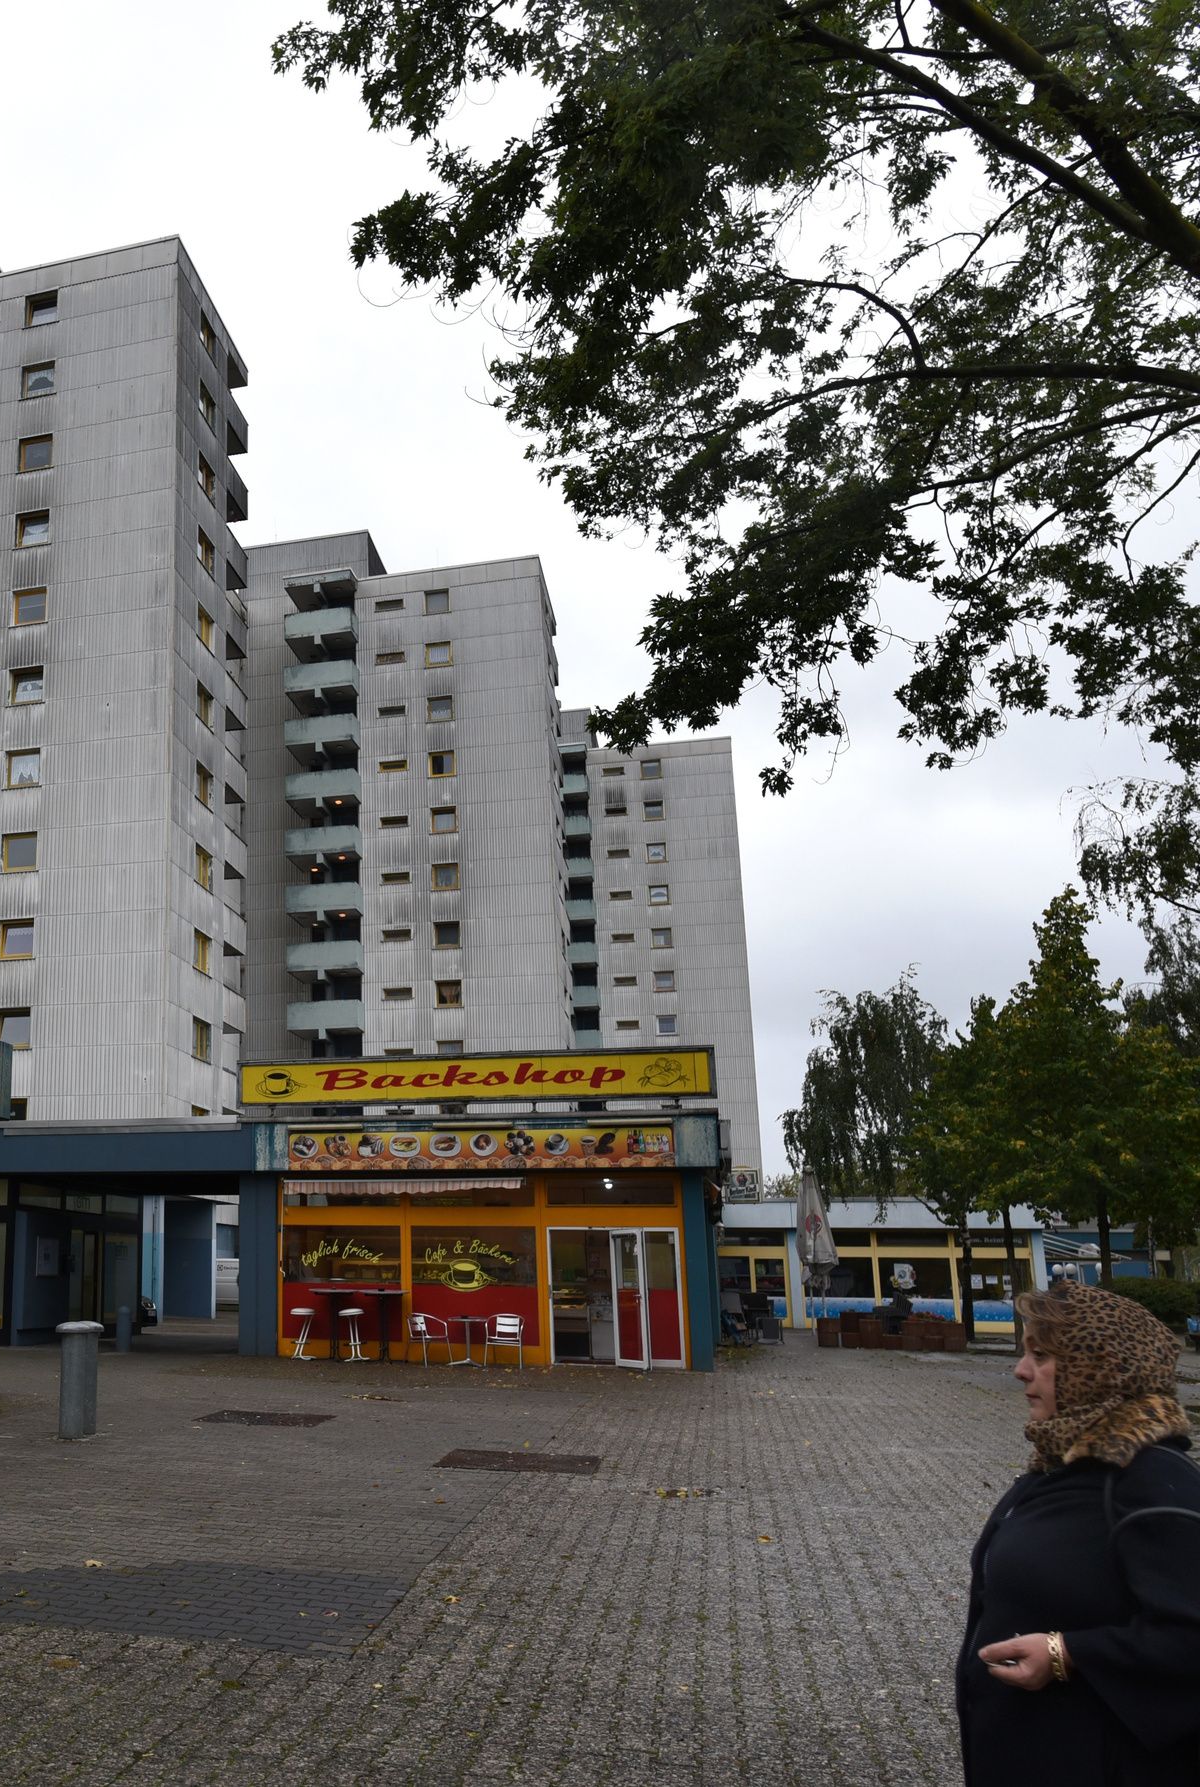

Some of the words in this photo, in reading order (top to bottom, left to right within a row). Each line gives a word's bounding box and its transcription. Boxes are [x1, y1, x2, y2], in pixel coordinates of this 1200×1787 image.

[315, 1062, 626, 1091] Backshop
[301, 1238, 340, 1267] täglich
[341, 1238, 384, 1264] frisch
[453, 1240, 465, 1254] &
[468, 1239, 520, 1265] Bäckerei
